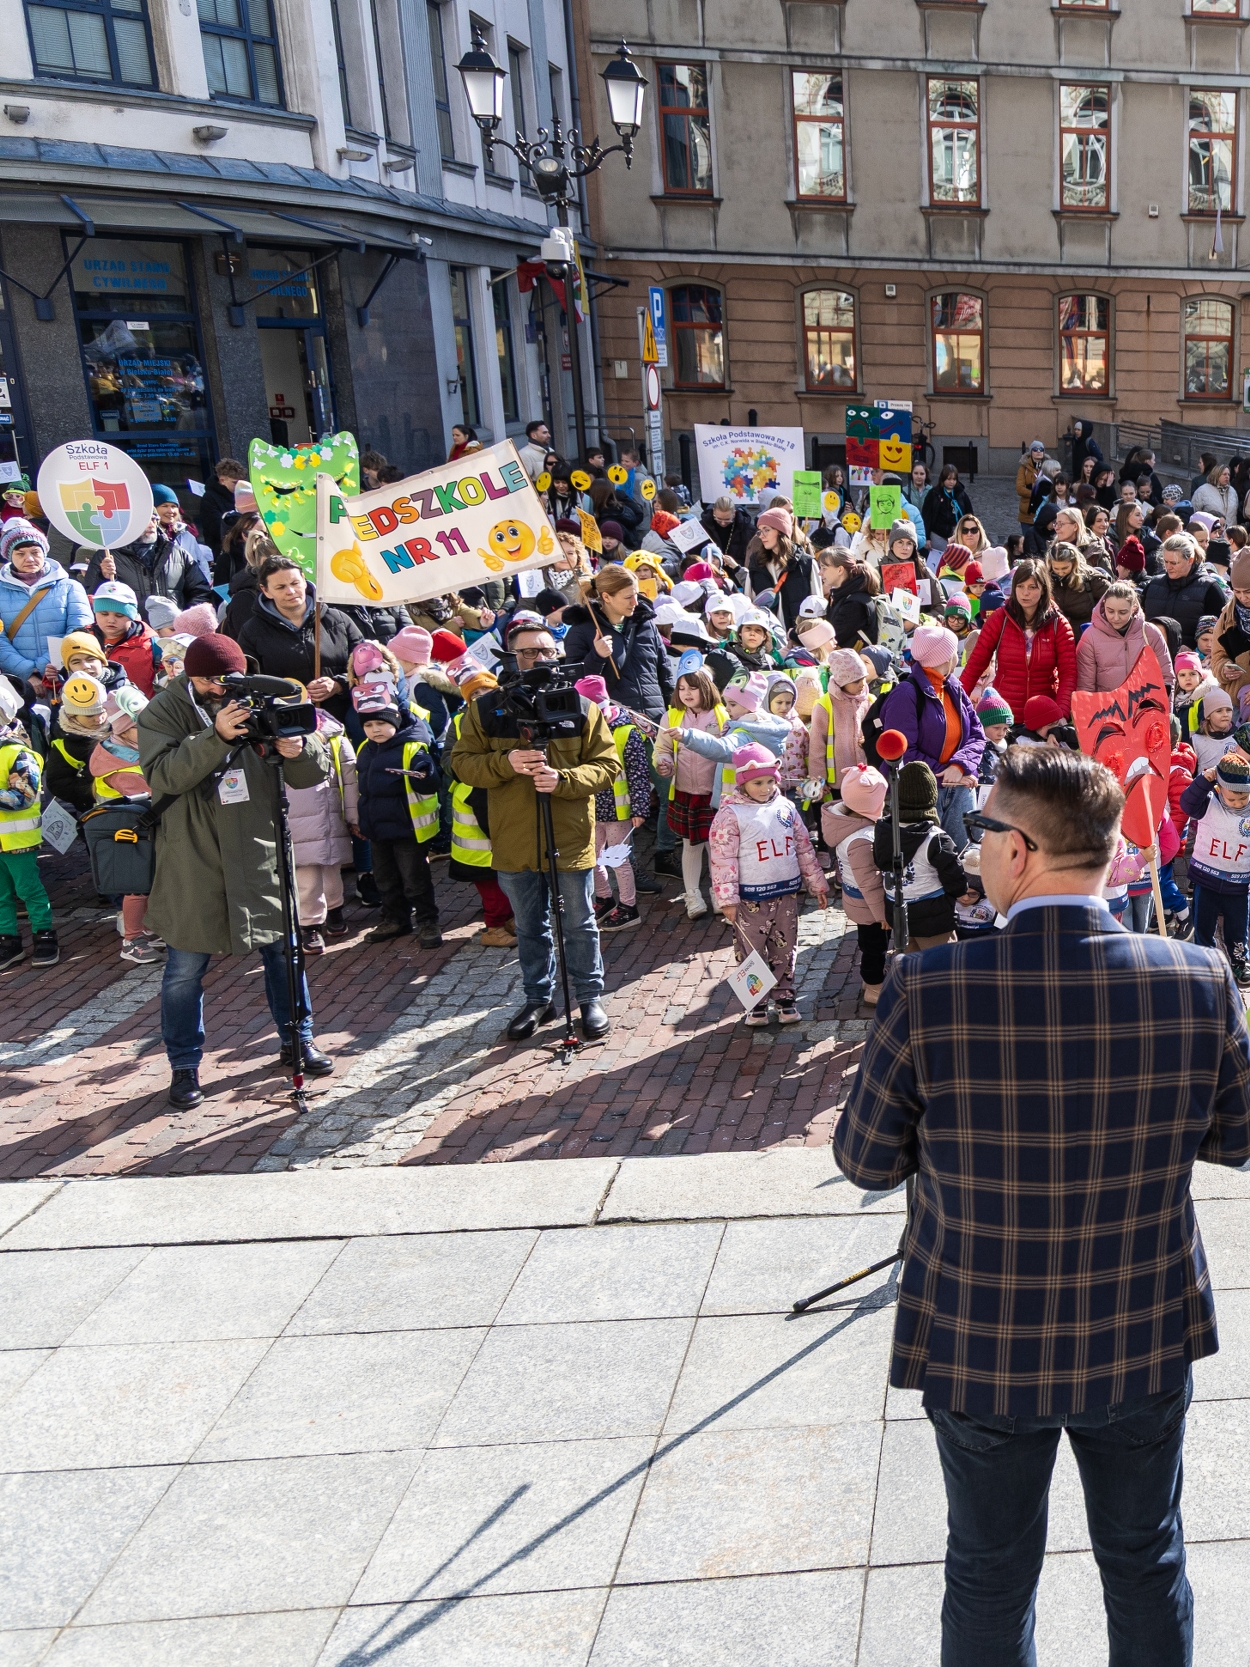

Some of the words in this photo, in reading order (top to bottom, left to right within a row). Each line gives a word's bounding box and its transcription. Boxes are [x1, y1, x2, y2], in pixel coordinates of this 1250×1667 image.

[653, 292, 662, 327] P
[65, 443, 108, 454] Szkoła
[702, 434, 727, 447] Szkoła
[728, 430, 775, 442] Podstawowa
[786, 441, 795, 450] 18
[79, 462, 99, 470] ELF
[104, 462, 109, 470] 1
[380, 537, 440, 574] NR
[435, 527, 470, 556] 11
[756, 836, 793, 861] ELF
[1209, 837, 1248, 861] ELF
